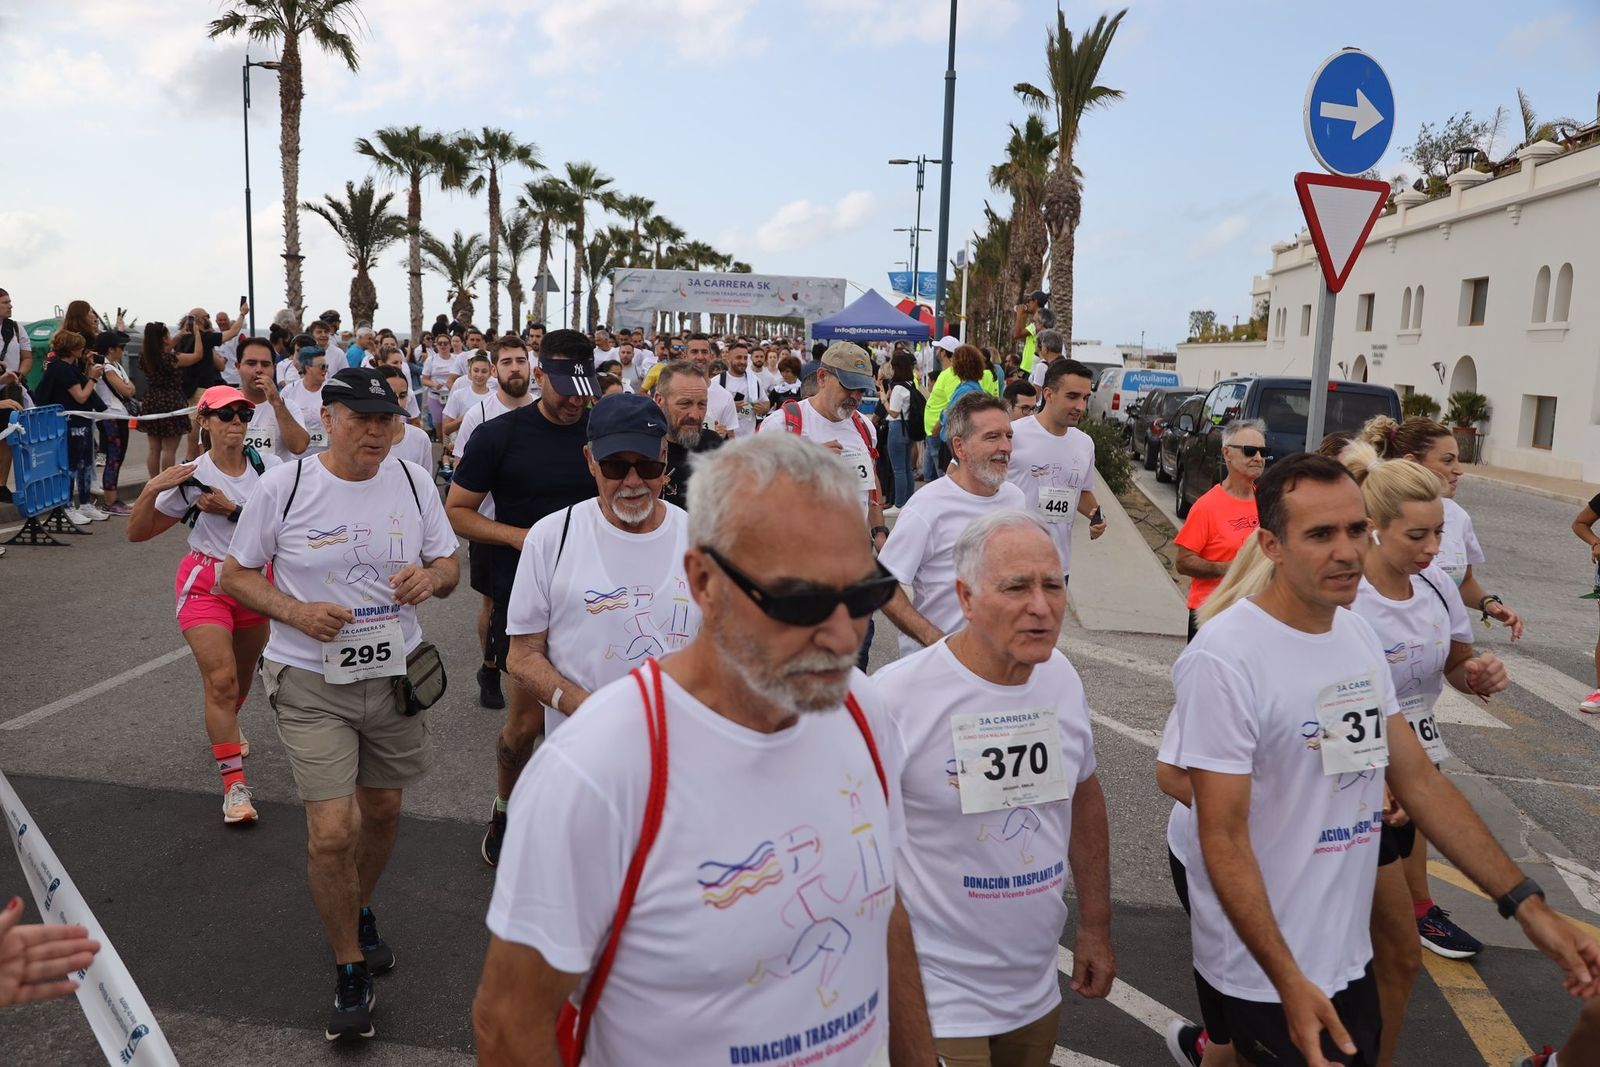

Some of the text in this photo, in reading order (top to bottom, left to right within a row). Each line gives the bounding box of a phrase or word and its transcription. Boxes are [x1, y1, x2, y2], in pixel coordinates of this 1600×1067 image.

[688, 278, 771, 290] 3A CARRERA 5K
[834, 327, 907, 336] info@dorsalchip.es
[245, 438, 272, 448] 264
[1045, 499, 1069, 513] 448
[351, 625, 378, 635] CARRERA
[340, 641, 392, 668] 295
[1349, 680, 1372, 690] CARR
[979, 716, 992, 726] 3A
[993, 713, 1032, 724] CARRERA
[981, 741, 1049, 781] 370
[963, 873, 1010, 890] DONACIÓN
[1012, 865, 1054, 889] TRASPLANTE
[968, 890, 1001, 900] Memorial
[1001, 889, 1025, 899] Vicente
[730, 1033, 802, 1065] DONACIÓN
[805, 1002, 866, 1048] TRASPLANTE
